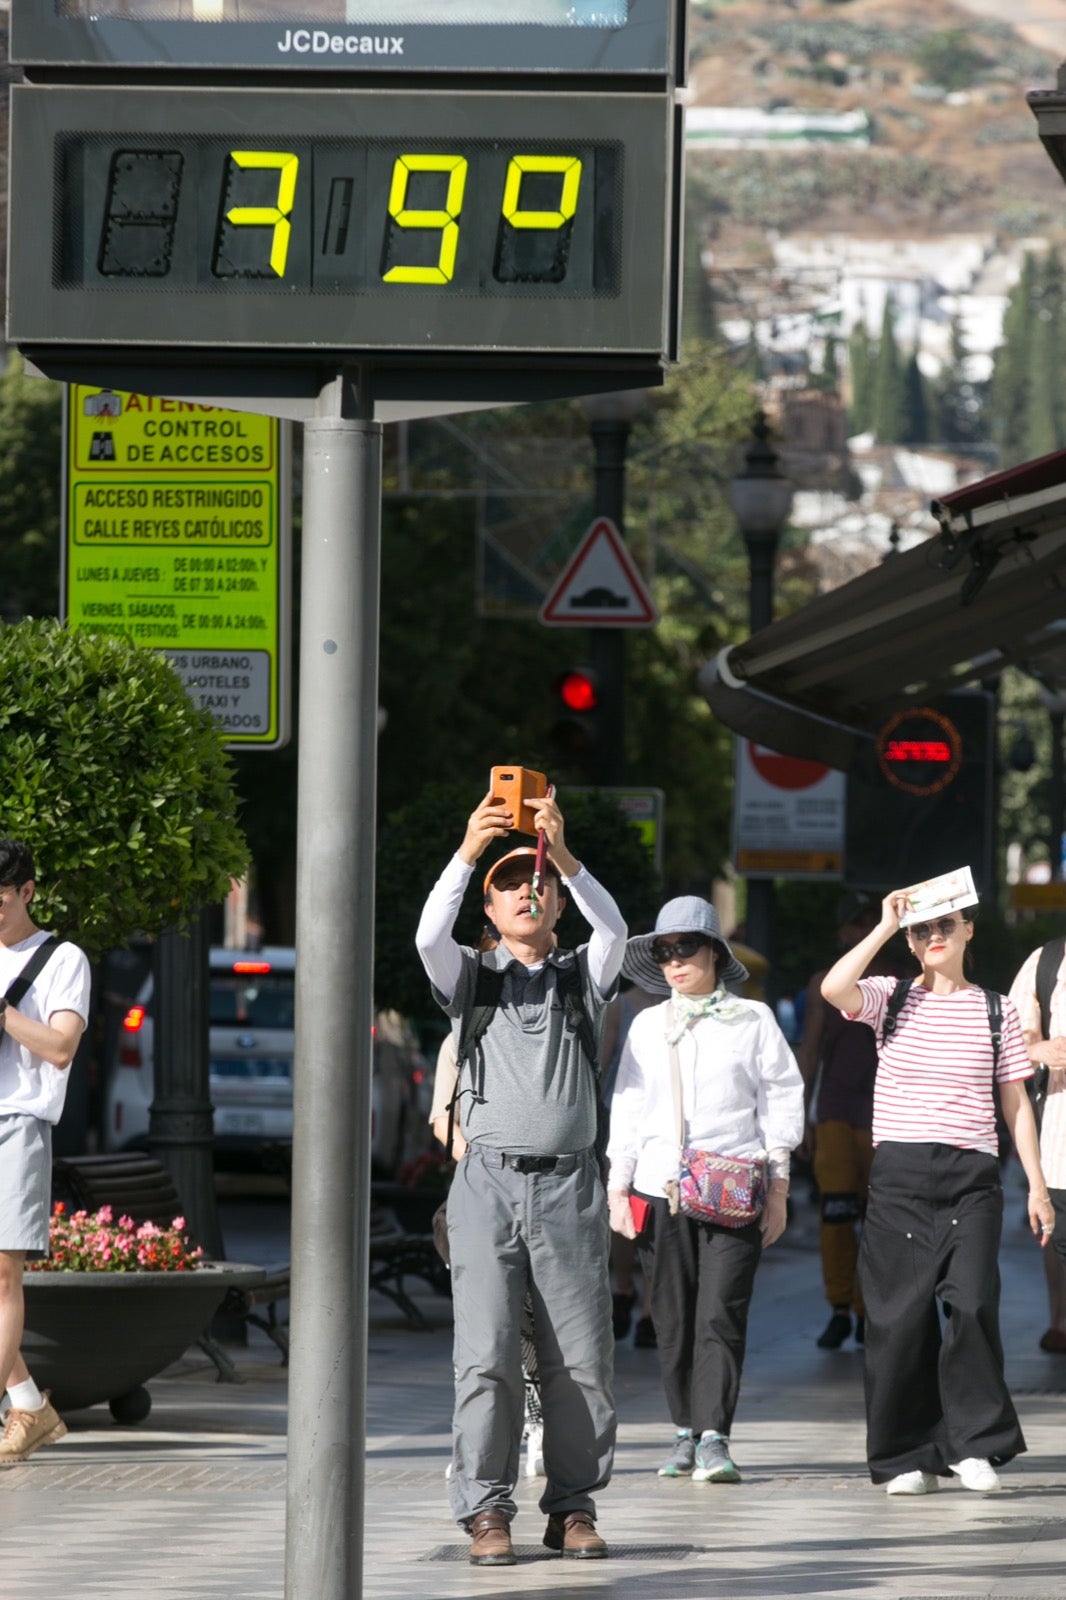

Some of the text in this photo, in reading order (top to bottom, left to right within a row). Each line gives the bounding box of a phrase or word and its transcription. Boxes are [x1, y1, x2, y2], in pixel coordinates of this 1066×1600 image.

[277, 30, 404, 54] JCDecaux
[143, 420, 248, 438] CONTROL
[127, 445, 264, 463] DE ACCESOS
[84, 489, 264, 508] ACCESO RESTRINGIDO
[83, 516, 264, 539] CALLE REYES CATÓLICOS
[260, 558, 268, 572] Y
[76, 567, 110, 582] LUNES
[112, 568, 119, 581] A
[191, 656, 253, 670] URBANO,
[188, 675, 250, 689] HOTELES
[199, 694, 241, 708] TAXI Y
